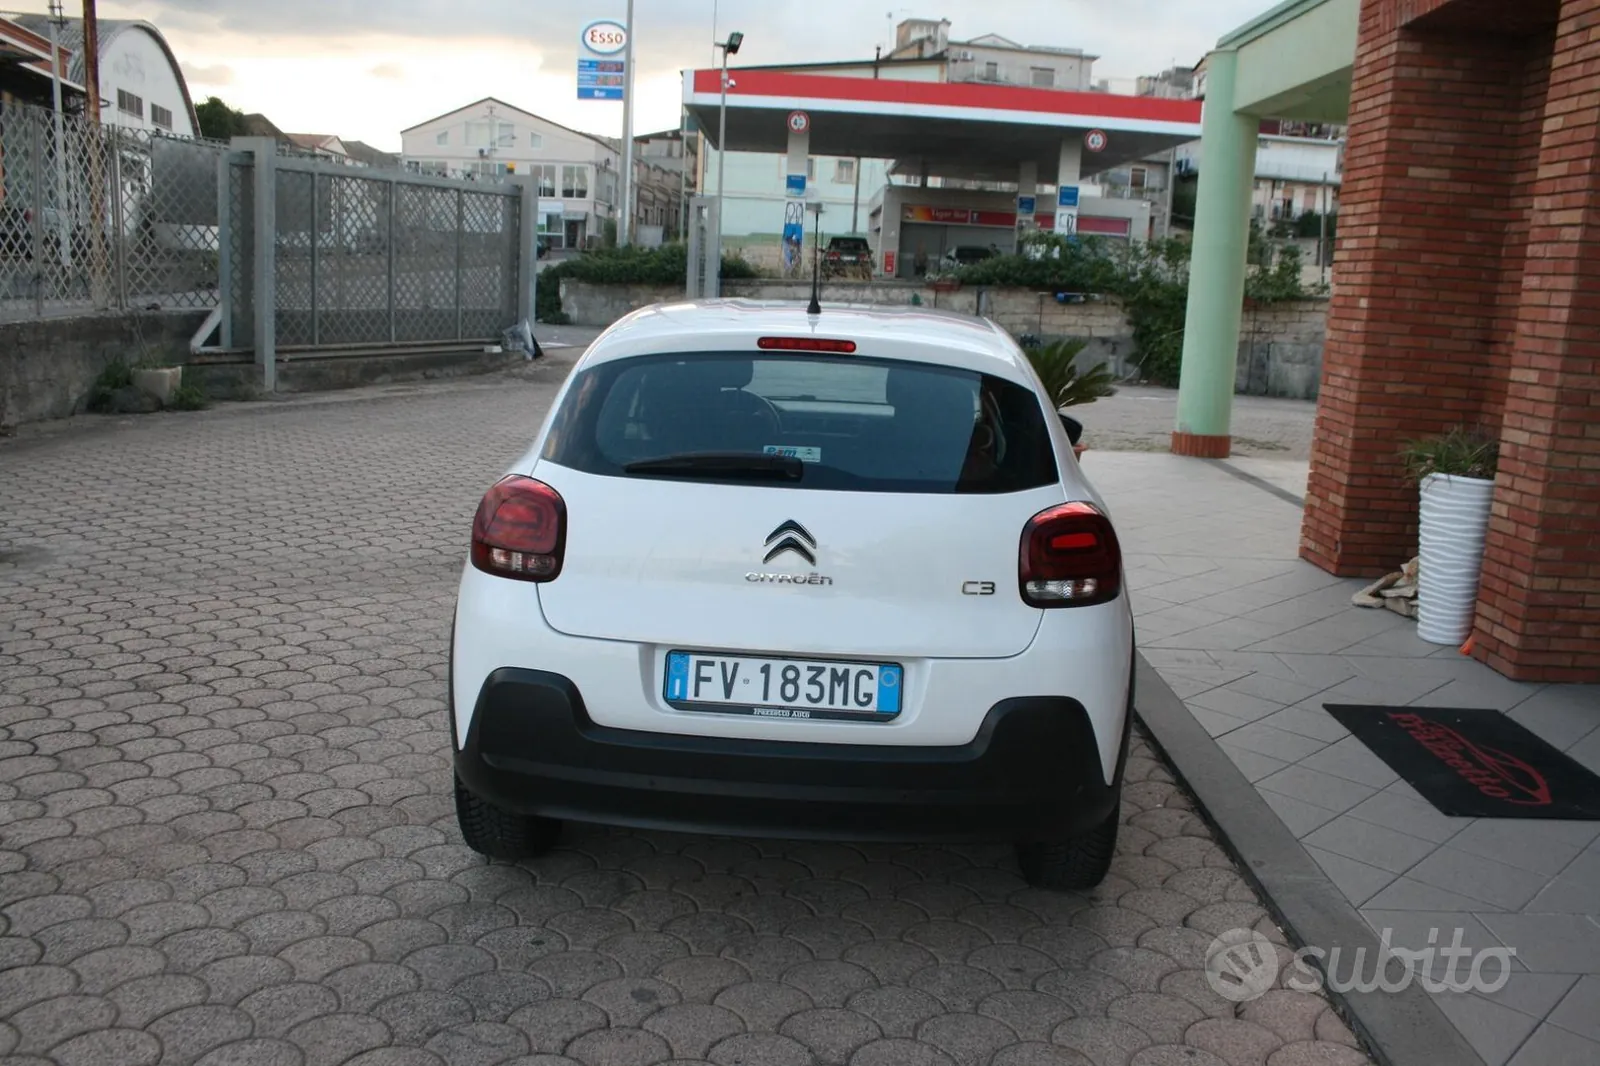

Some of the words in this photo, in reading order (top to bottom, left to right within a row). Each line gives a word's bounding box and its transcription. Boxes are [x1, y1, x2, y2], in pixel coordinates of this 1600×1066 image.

[590, 29, 623, 44] Esso
[961, 580, 996, 595] C3
[760, 663, 874, 708] 183MG
